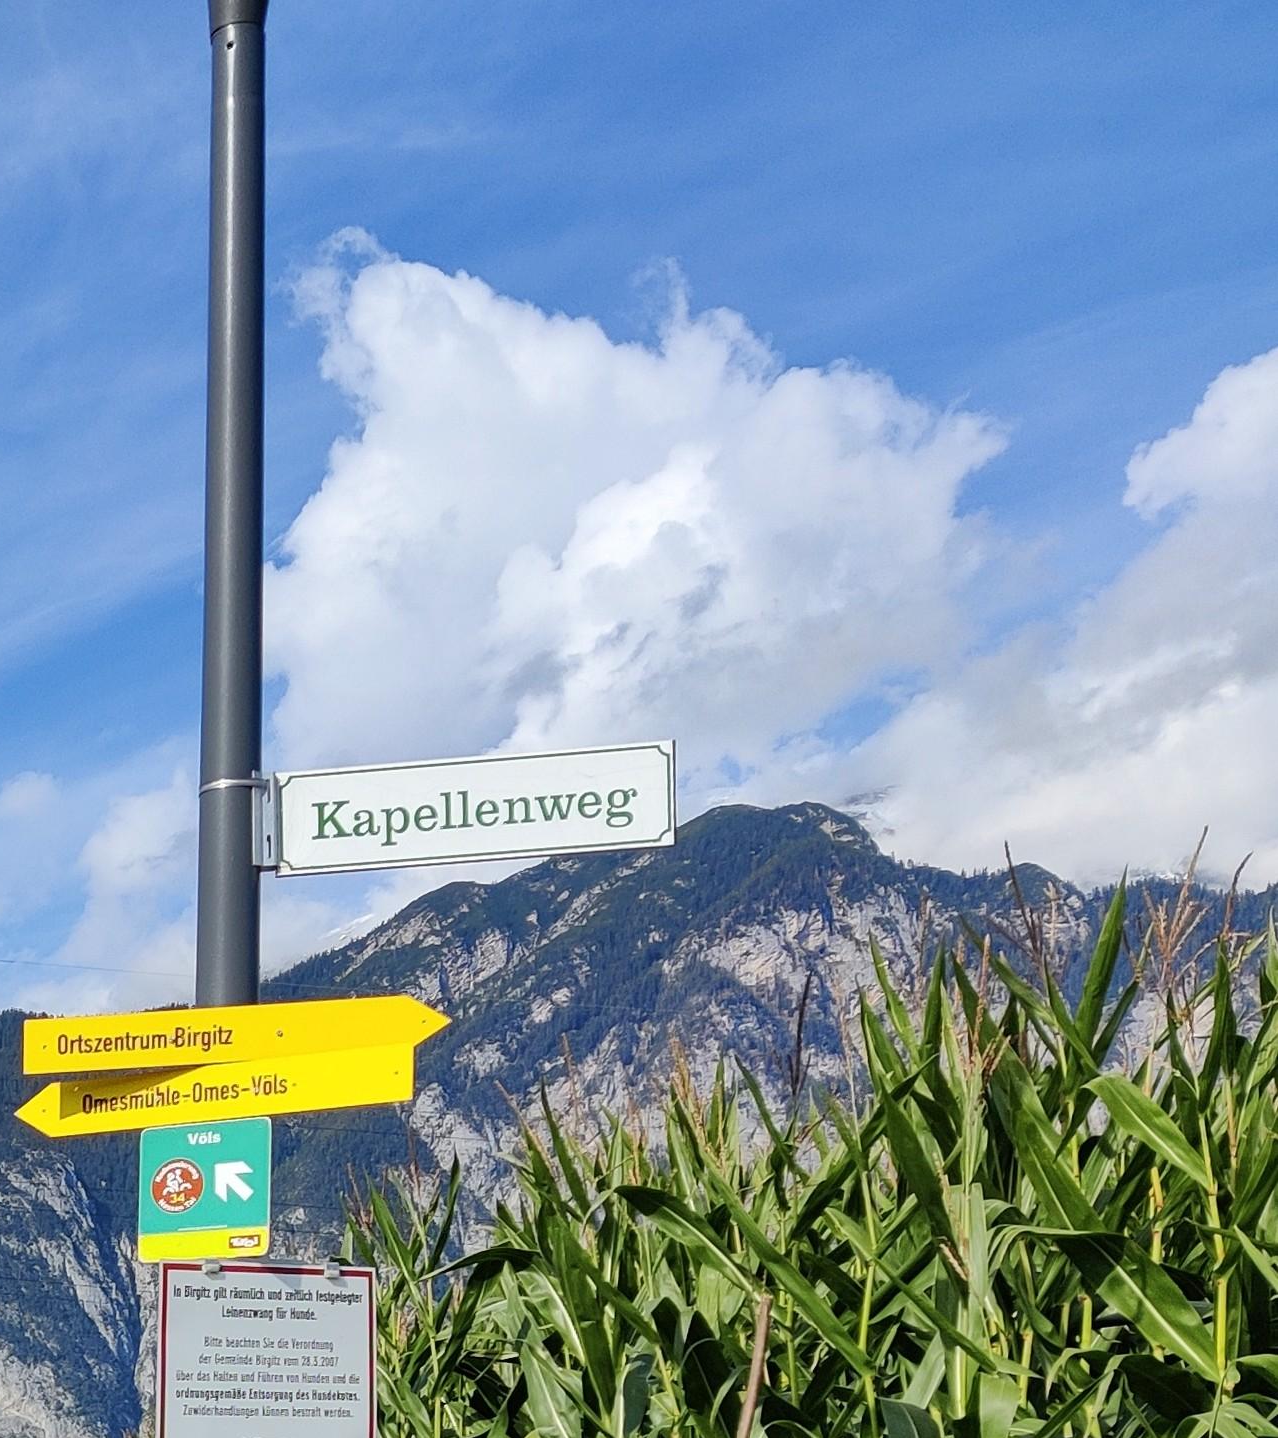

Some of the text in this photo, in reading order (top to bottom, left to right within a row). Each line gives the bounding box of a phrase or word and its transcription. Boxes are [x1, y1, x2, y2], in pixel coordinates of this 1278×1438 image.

[311, 787, 638, 846] Kapellenweg
[187, 1131, 221, 1145] Völs
[169, 1192, 185, 1204] 34
[184, 1285, 211, 1301] Birgitz
[230, 1287, 264, 1300] räumlich
[268, 1289, 281, 1301] und
[222, 1305, 273, 1321] Leinenzwang
[276, 1307, 287, 1319] für
[204, 1336, 334, 1352] Bitte beachten Sie die Verordnung
[199, 1353, 211, 1364] der
[214, 1354, 253, 1365] Gemeinde
[256, 1355, 281, 1368] Birgitz
[176, 1370, 360, 1384] über das Halten und Führen von Hunden und die
[176, 1388, 247, 1402] ordnungsgemäße
[249, 1388, 293, 1402] Entsorgung
[296, 1389, 310, 1400] des
[183, 1404, 259, 1419] Zuwiderhandlungen
[262, 1405, 290, 1417] können
